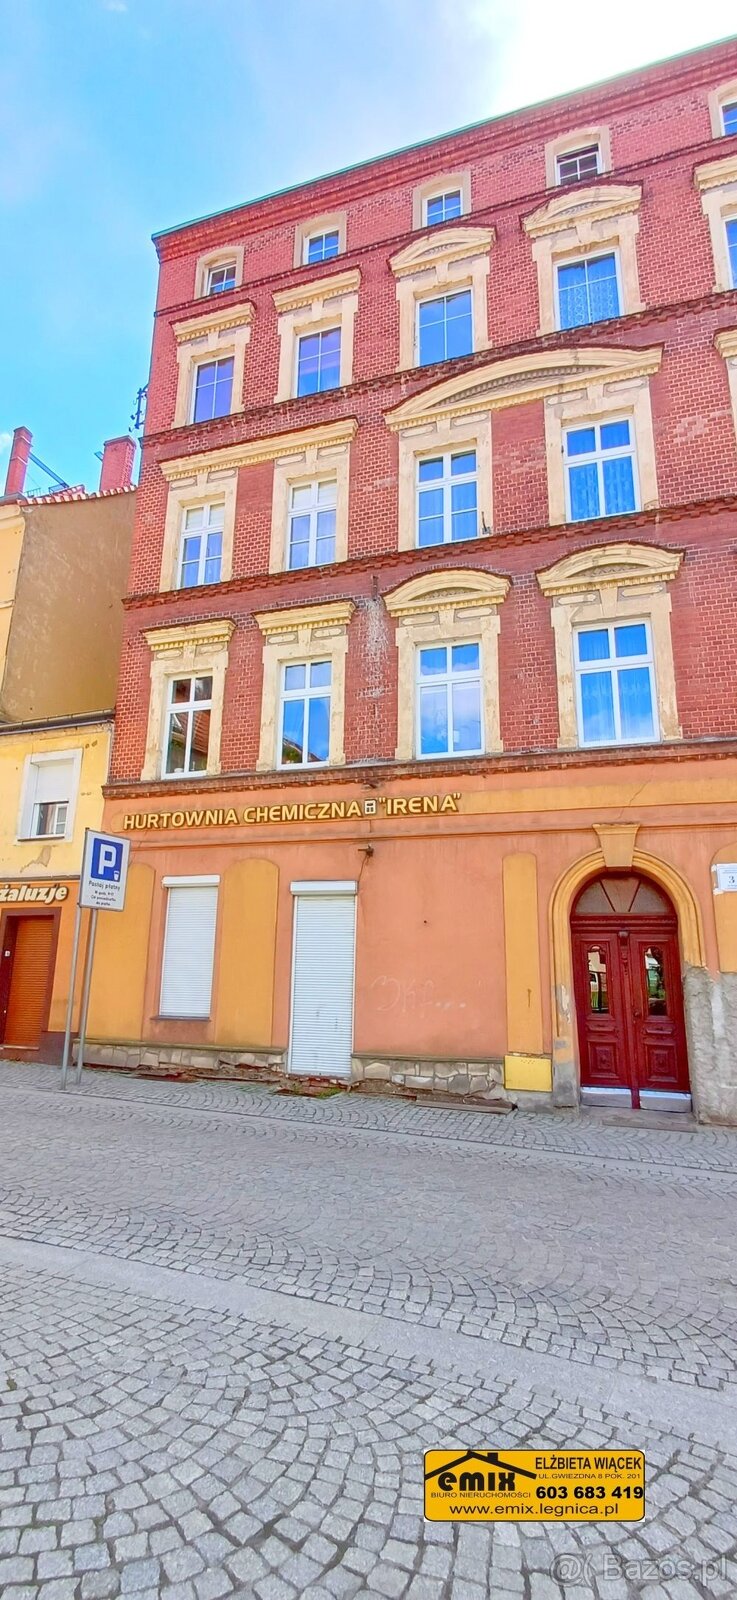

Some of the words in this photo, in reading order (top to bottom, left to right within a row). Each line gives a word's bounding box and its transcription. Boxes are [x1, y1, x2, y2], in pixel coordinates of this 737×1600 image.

[123, 809, 239, 830] HURTOWNIA
[243, 801, 362, 823] CHEMICZNA
[378, 792, 462, 815] "IRENA"
[98, 844, 116, 874] P
[0, 884, 68, 905] żaluzje
